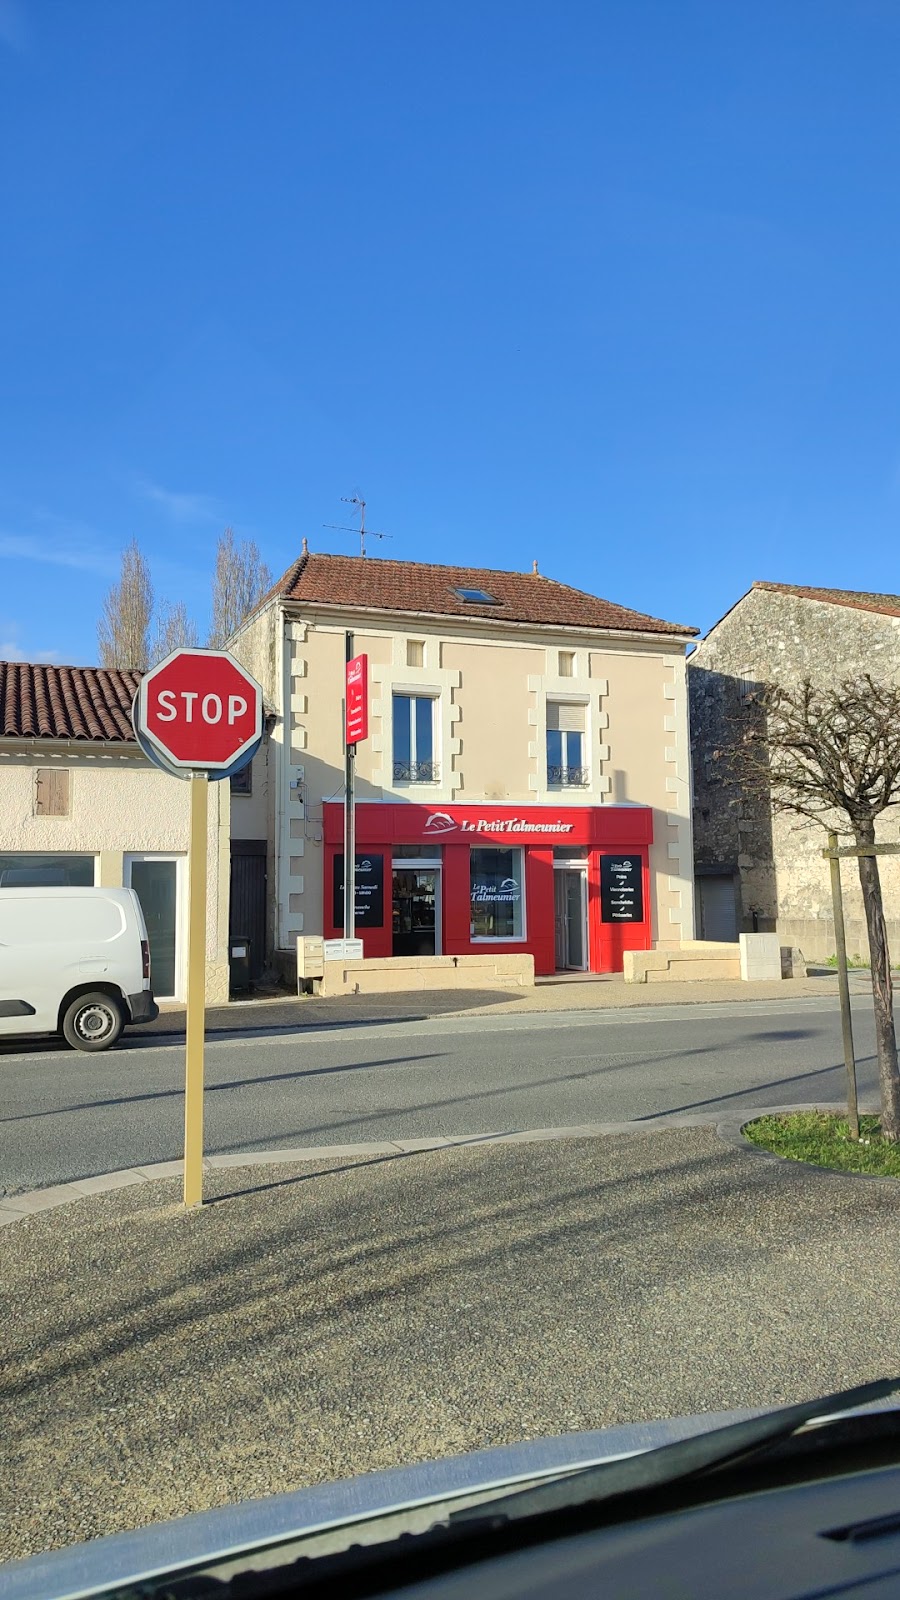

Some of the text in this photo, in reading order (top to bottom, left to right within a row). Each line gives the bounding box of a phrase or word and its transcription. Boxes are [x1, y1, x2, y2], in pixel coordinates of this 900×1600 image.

[156, 690, 248, 725] STOP
[460, 818, 574, 833] Le Petit Talmeunier
[479, 885, 497, 894] Petit
[470, 891, 521, 902] Talmeunier
